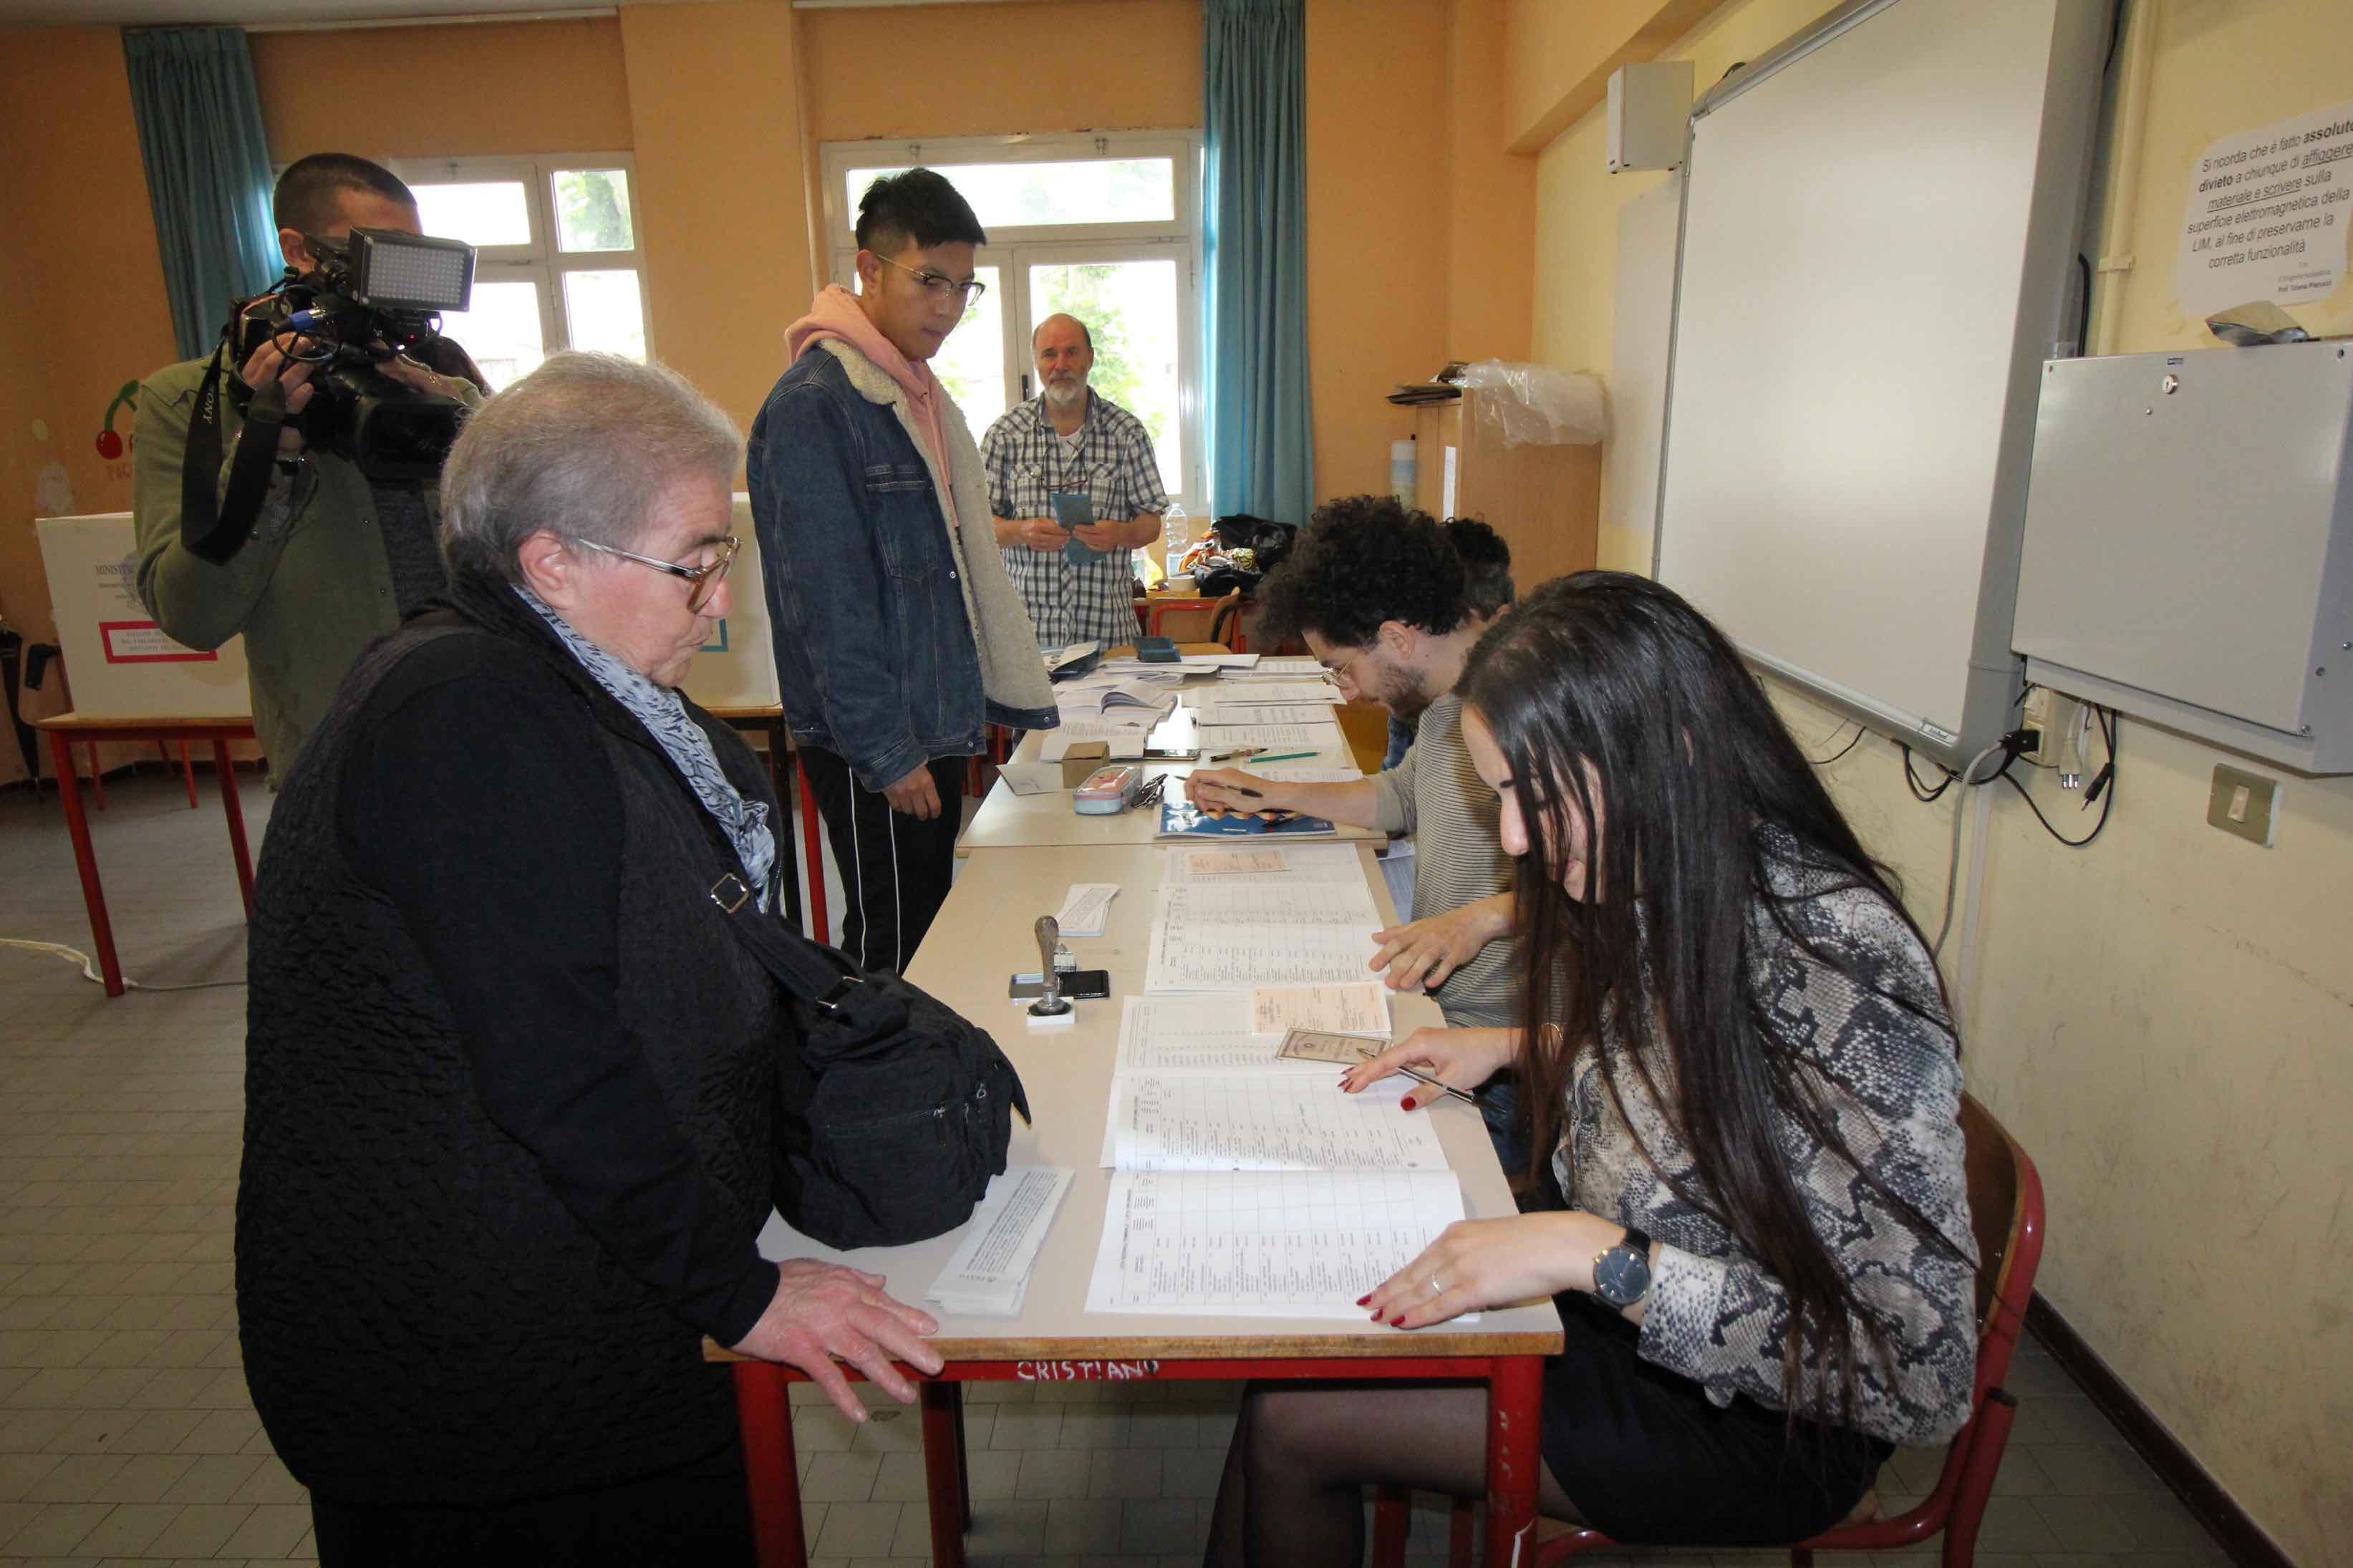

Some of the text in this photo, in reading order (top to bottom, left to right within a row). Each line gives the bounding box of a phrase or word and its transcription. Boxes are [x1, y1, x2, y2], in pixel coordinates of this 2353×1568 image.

[2202, 158, 2211, 173] Si
[2213, 149, 2246, 171] ricorda
[2250, 144, 2268, 160] che
[2279, 135, 2301, 151] fatto
[2199, 175, 2233, 193] divieto
[2235, 173, 2243, 184] a
[2244, 160, 2288, 182] chiunque
[2290, 155, 2299, 169] di
[2208, 168, 2332, 209] materiale e scrivere sulla
[2188, 187, 2349, 235] superficie elettromagnetica della
[2216, 234, 2224, 248] al
[2226, 231, 2245, 246] fine
[2246, 227, 2255, 241] di
[2257, 217, 2320, 240] preservarne
[2323, 213, 2334, 227] la
[2208, 251, 2245, 268] corretta
